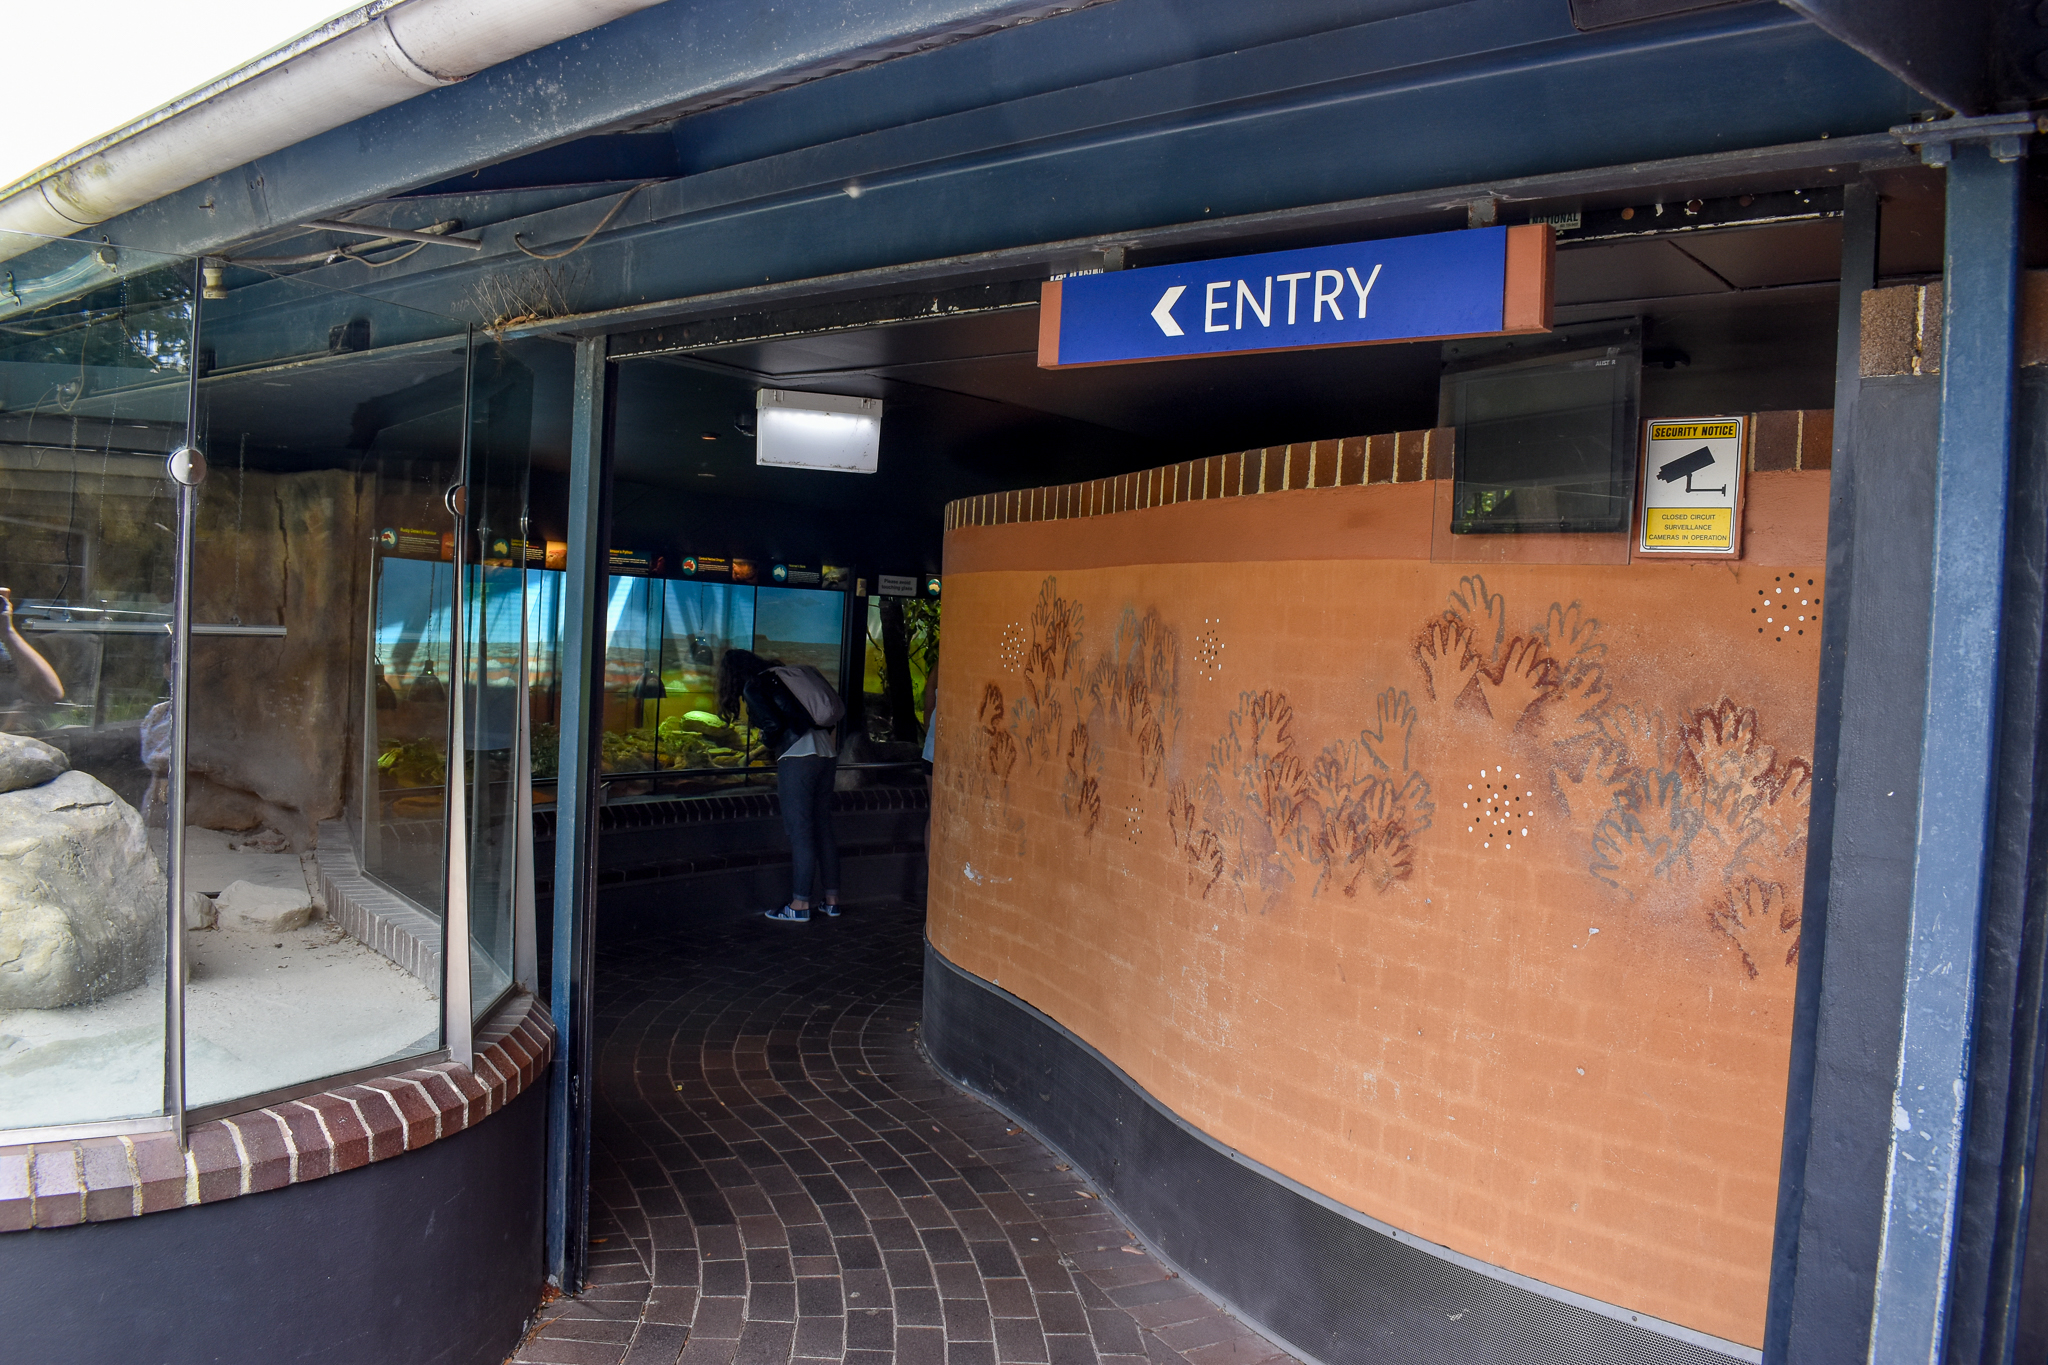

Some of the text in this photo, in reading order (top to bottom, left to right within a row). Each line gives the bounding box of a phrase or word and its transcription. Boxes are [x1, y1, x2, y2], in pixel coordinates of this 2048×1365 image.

[1532, 213, 1578, 224] NATIONAL
[1204, 263, 1382, 333] ENTRY
[1655, 425, 1734, 438] SECURITY NOTICE
